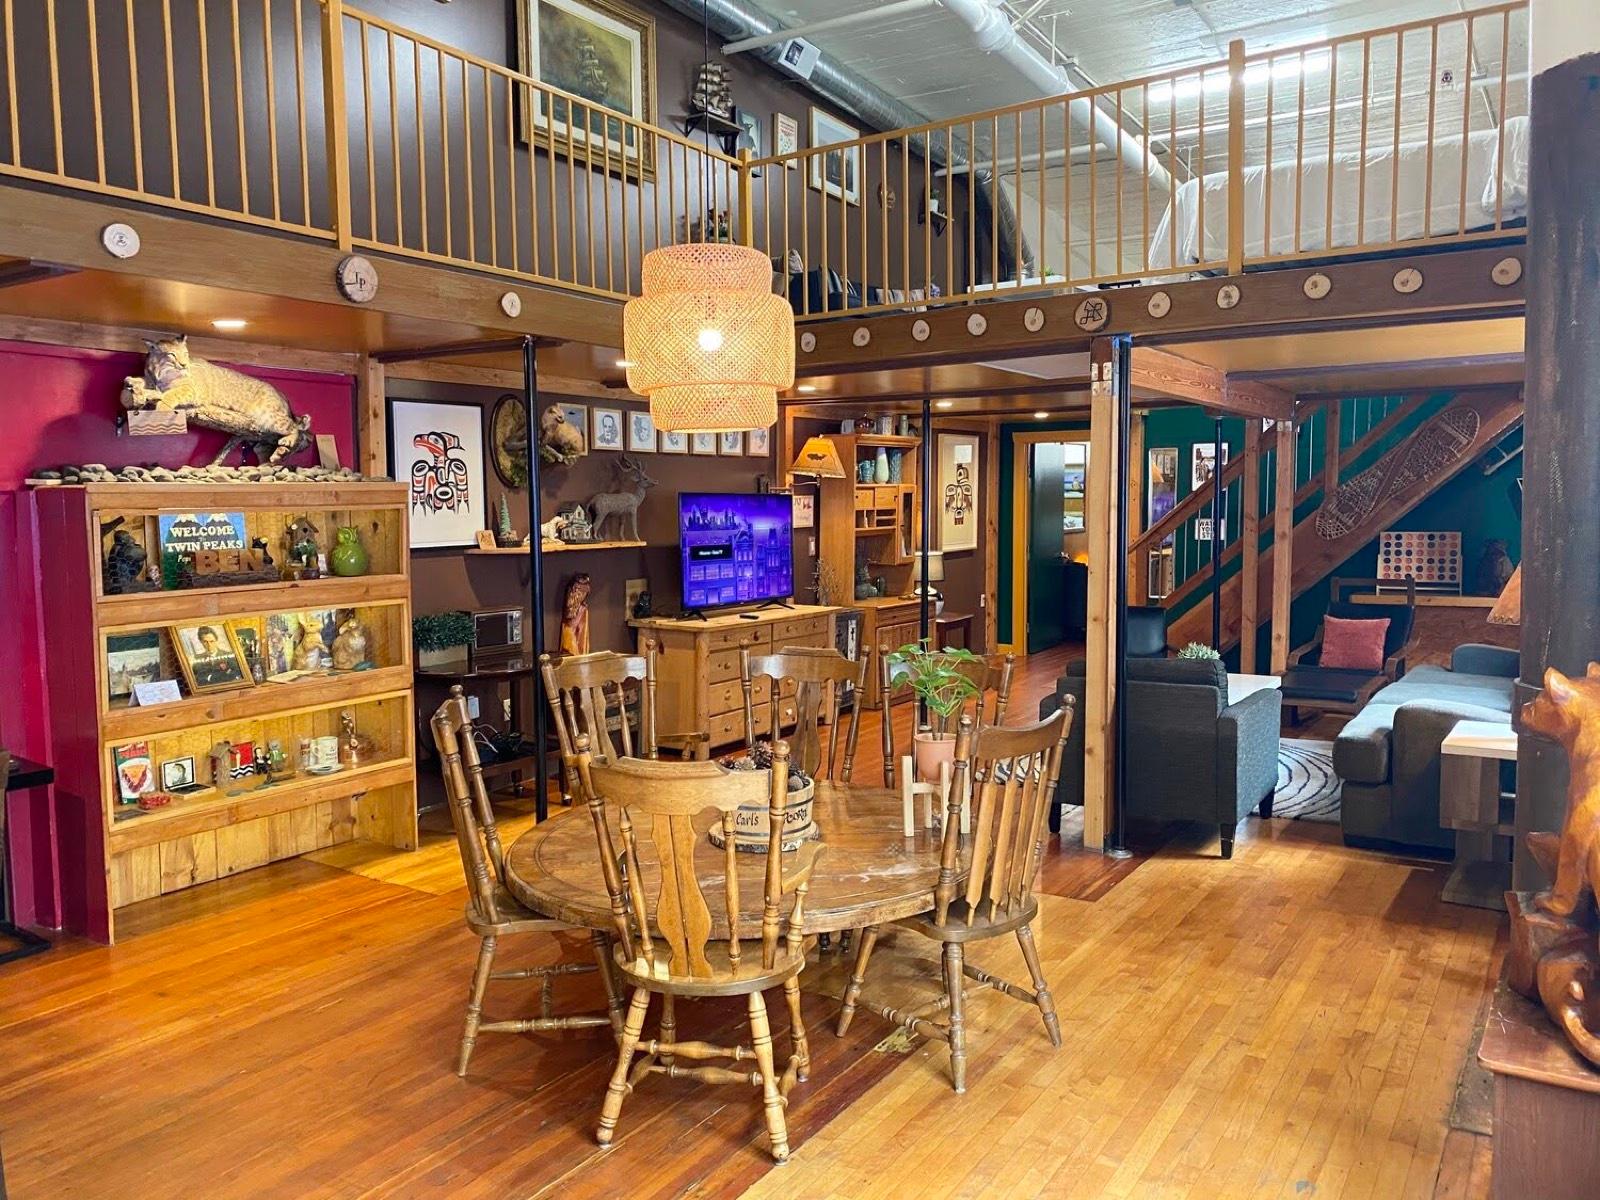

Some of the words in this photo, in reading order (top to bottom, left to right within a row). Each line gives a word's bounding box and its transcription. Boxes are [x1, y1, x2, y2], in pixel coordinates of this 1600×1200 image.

[169, 525, 235, 538] WELCOME
[165, 541, 200, 553] TWIN
[202, 539, 244, 550] PEAKS
[195, 547, 265, 575] BEN
